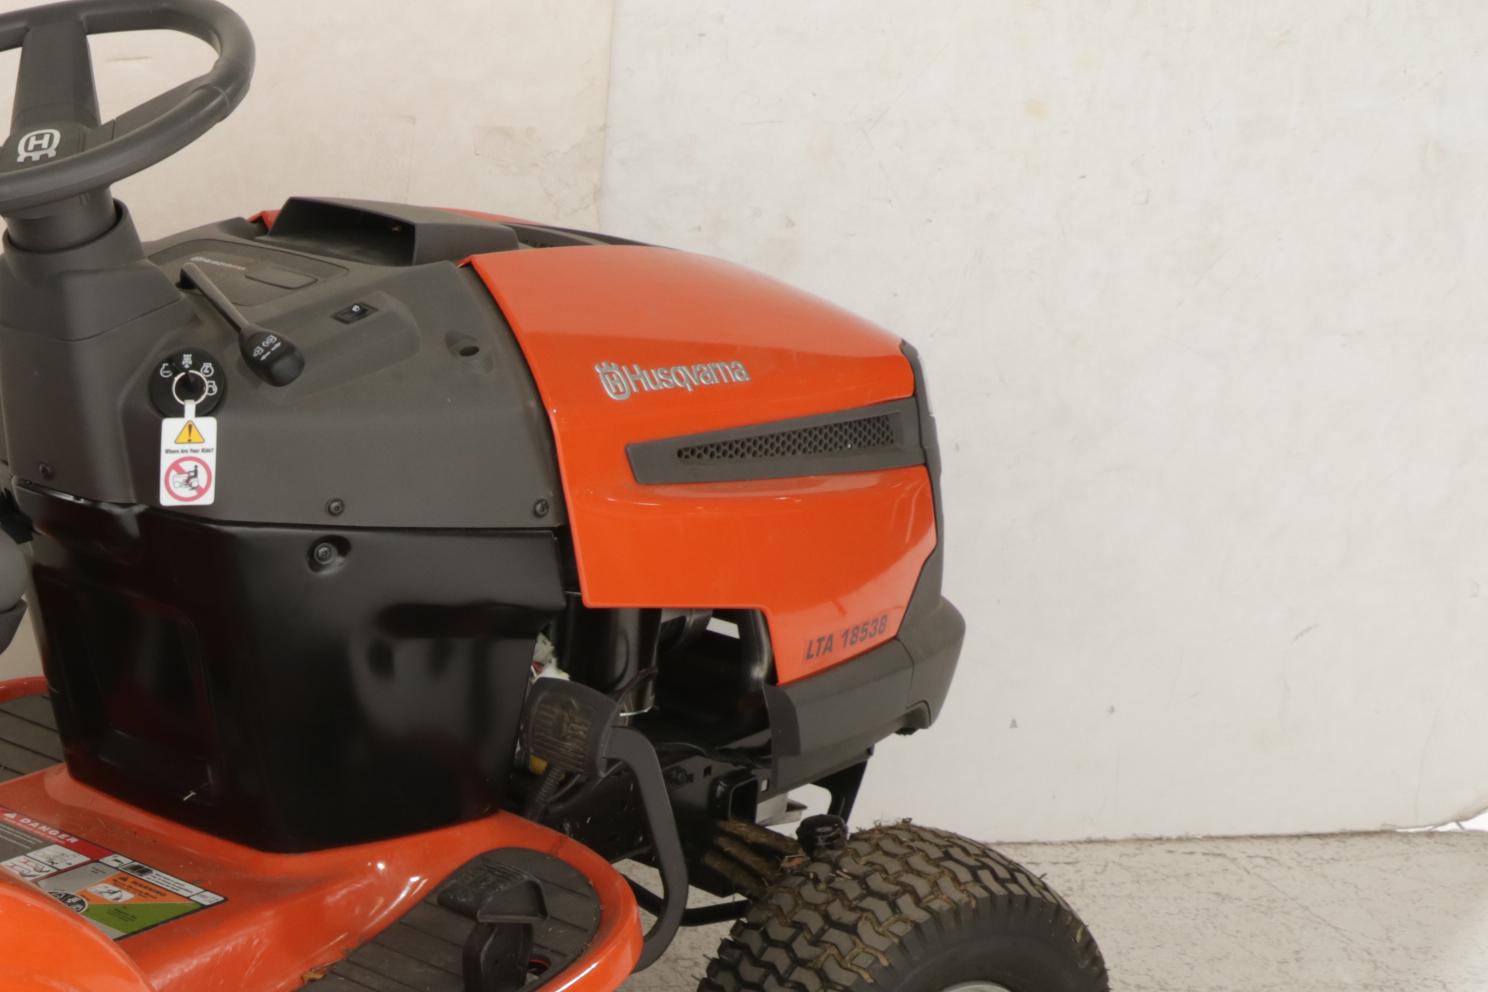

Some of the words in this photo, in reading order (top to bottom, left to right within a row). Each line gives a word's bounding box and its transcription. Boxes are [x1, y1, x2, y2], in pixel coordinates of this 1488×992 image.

[624, 361, 751, 392] Husqvarna
[805, 633, 834, 660] LTA
[841, 614, 889, 648] 18538
[19, 817, 80, 844] DANGER
